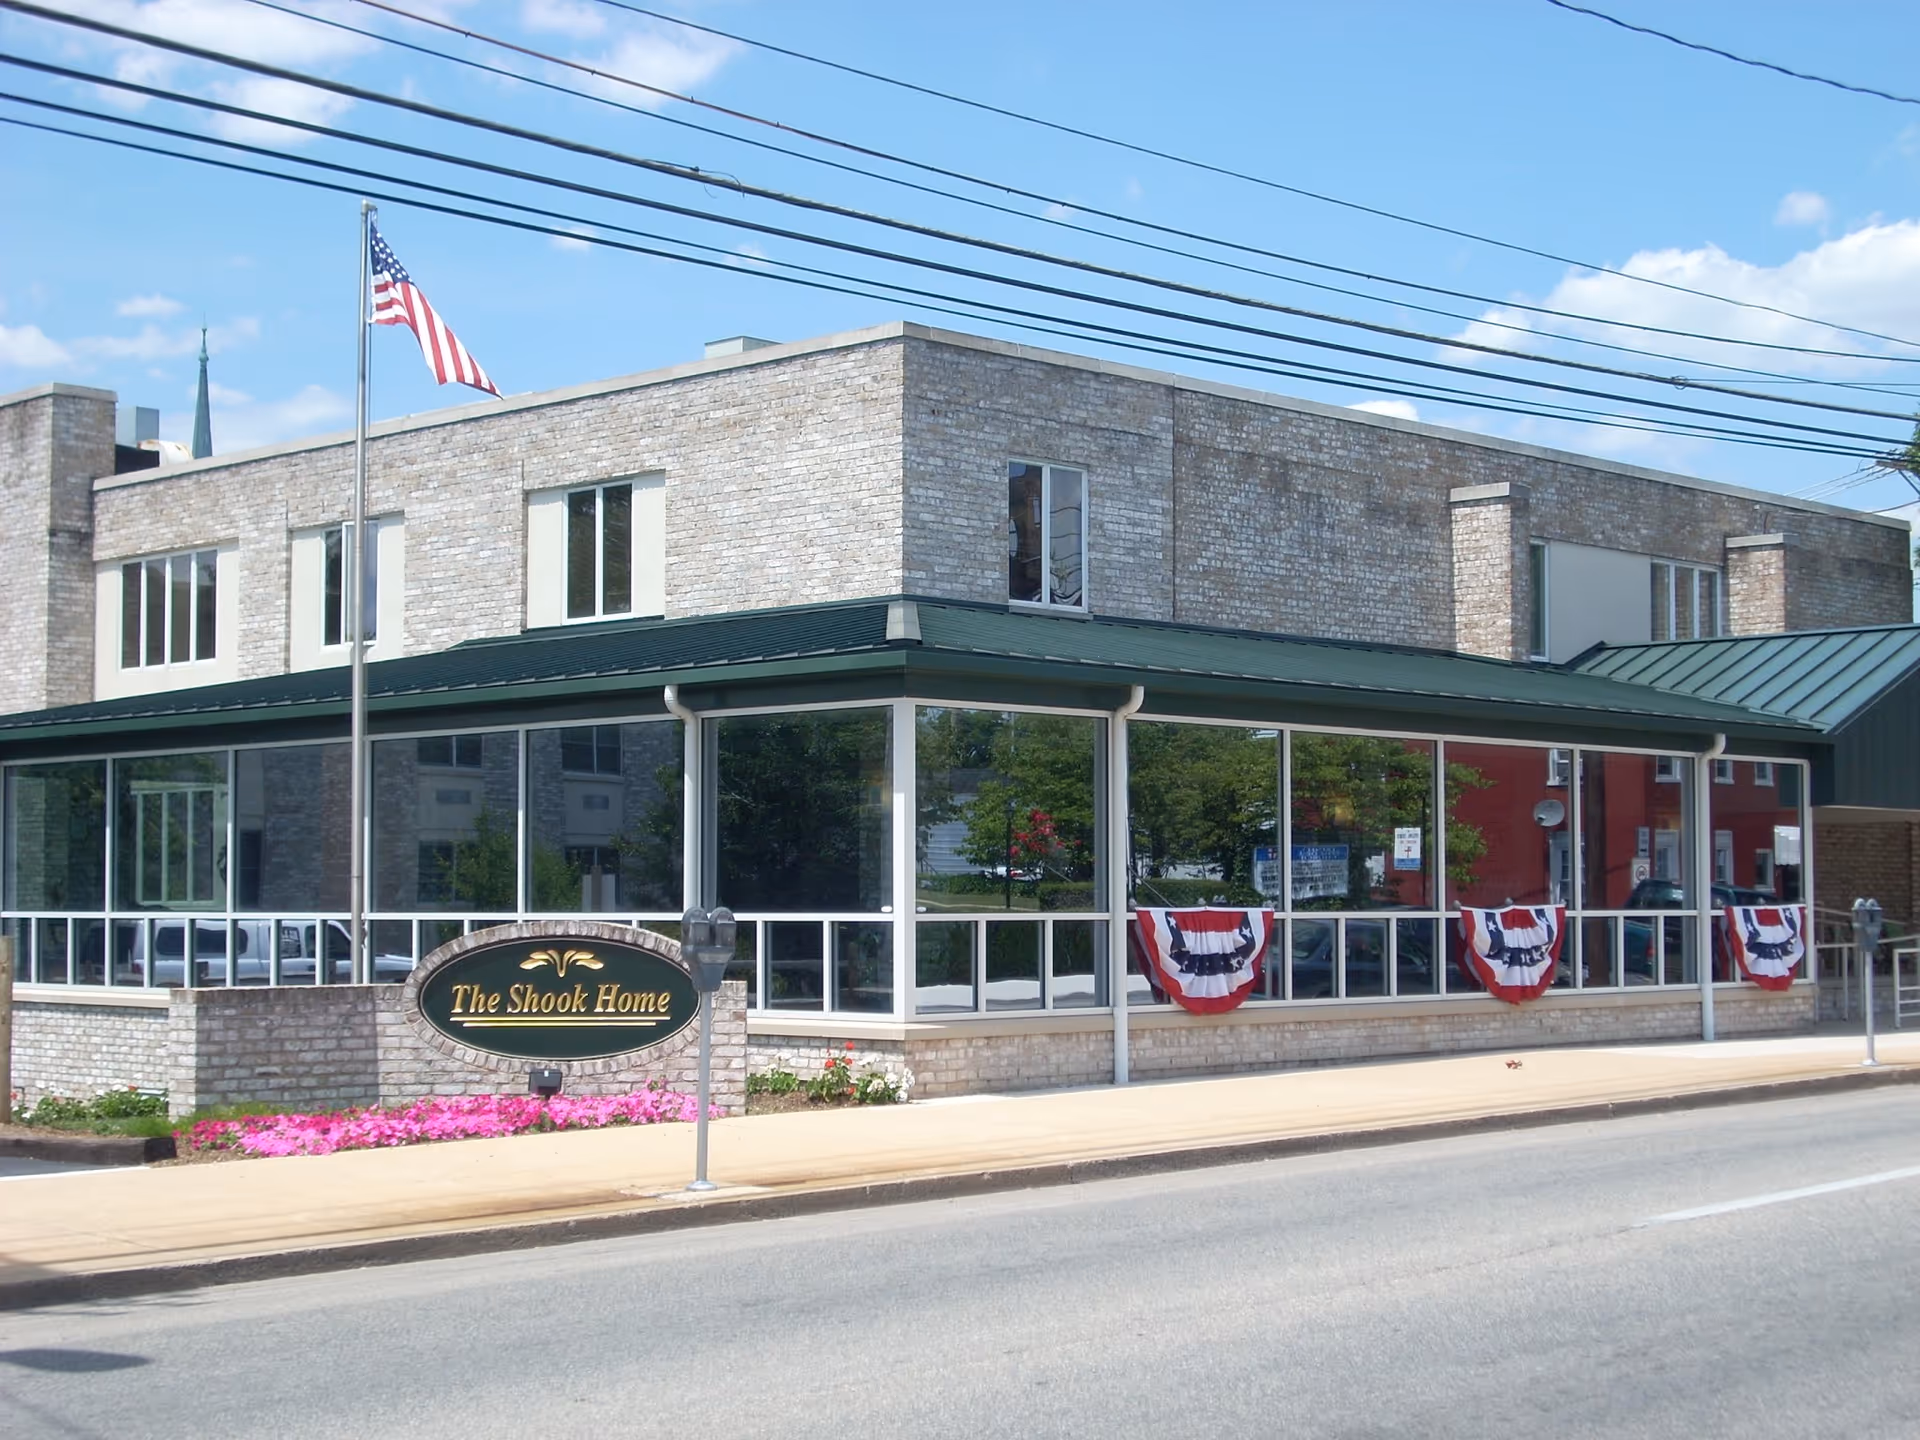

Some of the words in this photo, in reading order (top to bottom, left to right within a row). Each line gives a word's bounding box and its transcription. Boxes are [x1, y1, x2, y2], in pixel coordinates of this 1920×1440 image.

[451, 984, 500, 1013] The
[507, 983, 588, 1013] Shook
[593, 984, 671, 1013] Home
